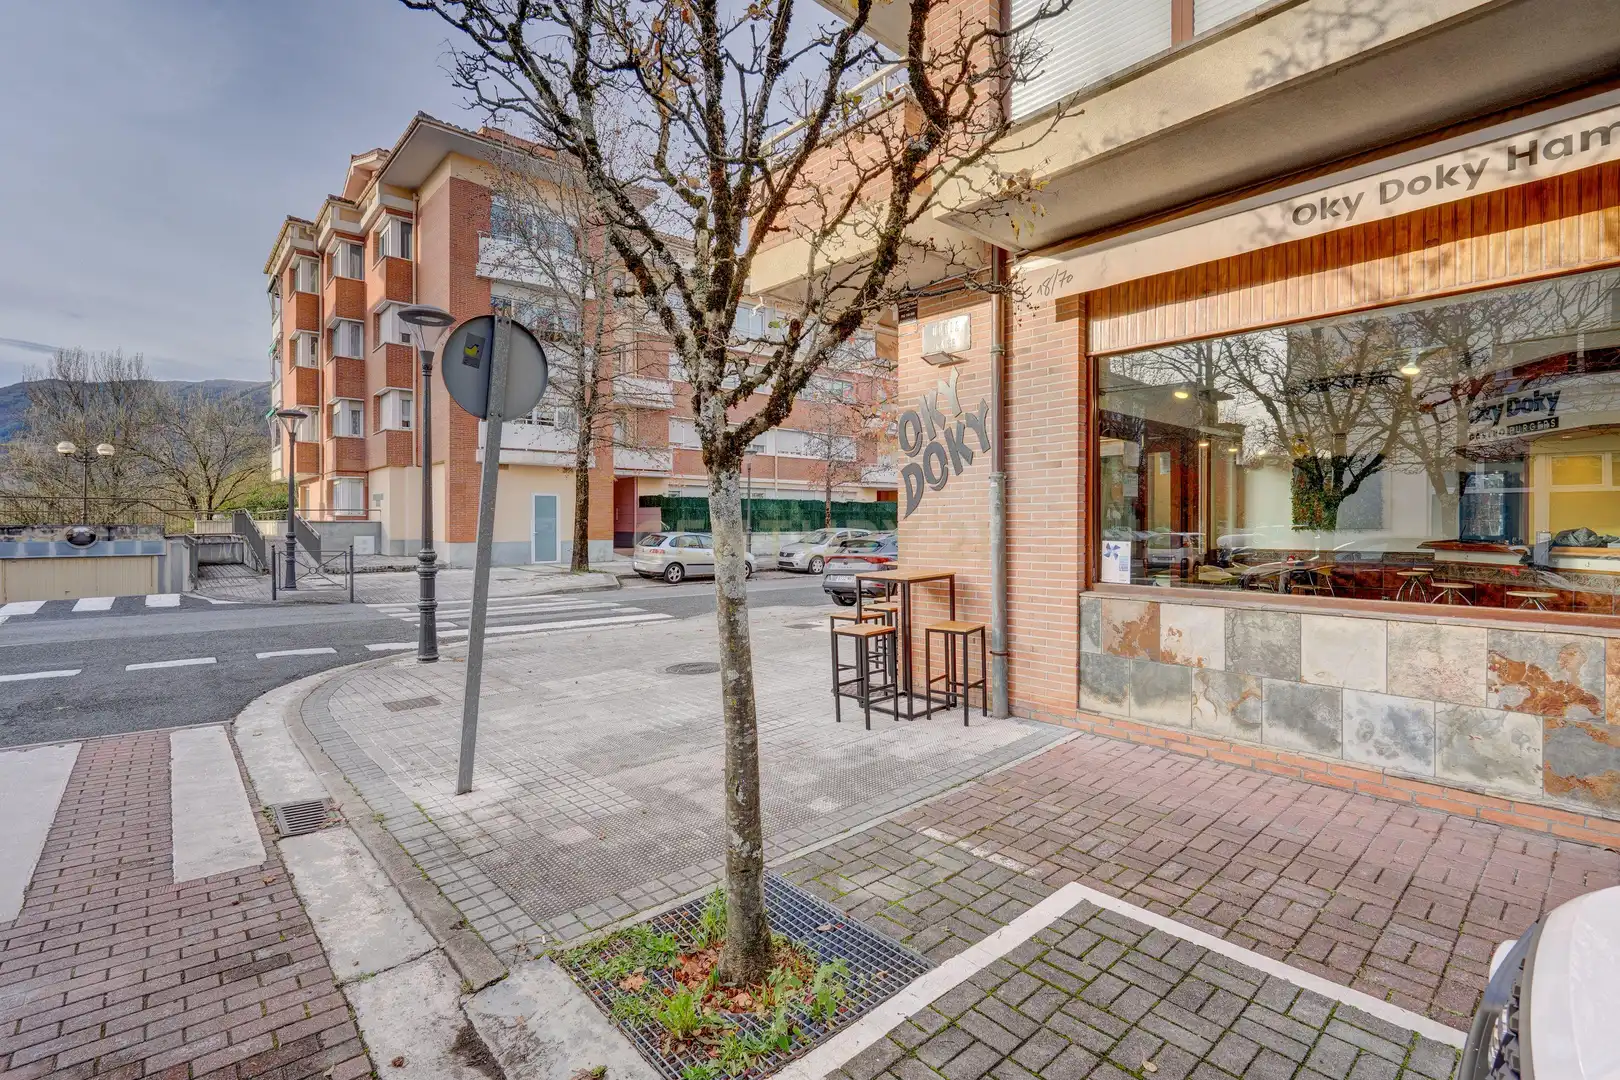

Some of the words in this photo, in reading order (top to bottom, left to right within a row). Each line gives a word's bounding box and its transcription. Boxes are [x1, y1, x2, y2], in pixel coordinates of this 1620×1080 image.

[1379, 157, 1490, 205] Doky
[899, 366, 962, 457] OKY
[901, 398, 991, 519] DOKY
